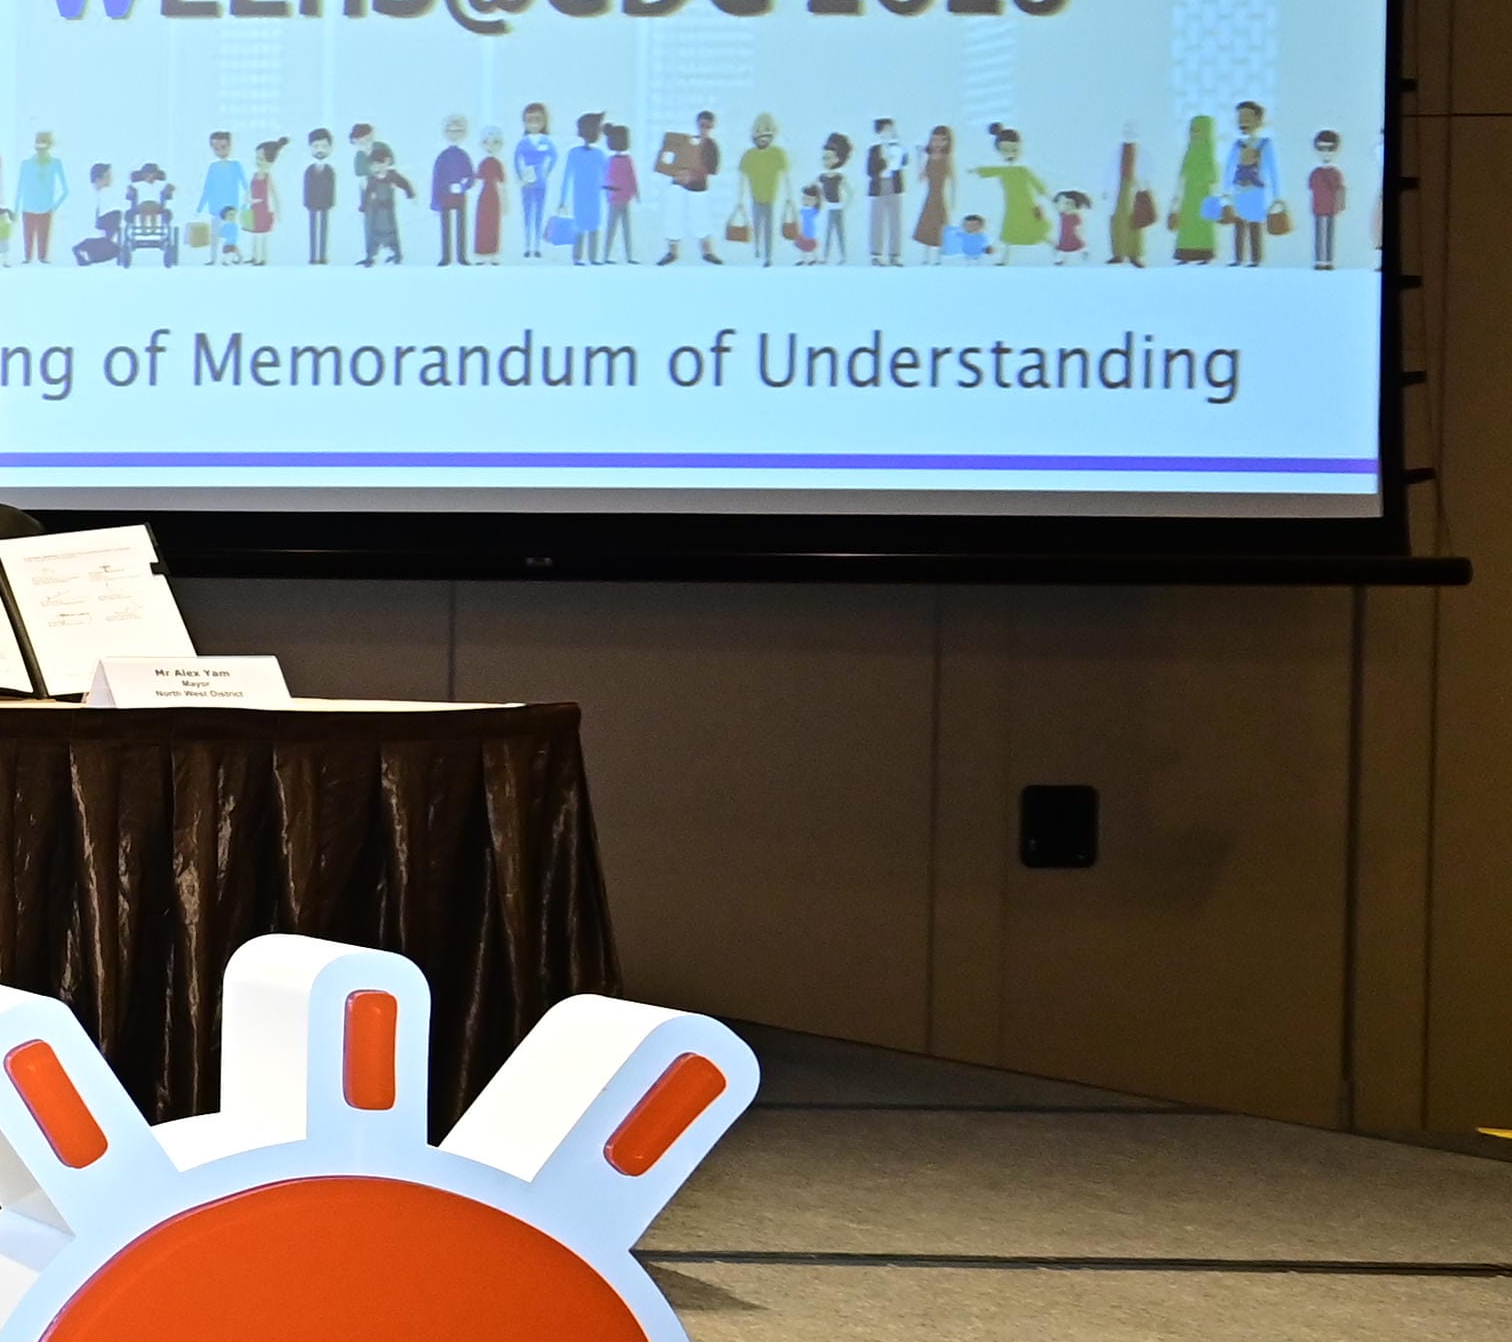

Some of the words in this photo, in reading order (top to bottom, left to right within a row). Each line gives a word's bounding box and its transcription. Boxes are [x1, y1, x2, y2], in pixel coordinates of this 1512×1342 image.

[103, 328, 171, 387] of
[193, 328, 640, 388] Memorandum
[668, 328, 737, 388] of
[758, 329, 1242, 405] Understanding
[154, 669, 170, 677] Mr
[174, 669, 201, 677] Alex
[203, 669, 231, 677] Yam
[181, 680, 211, 688] Mayor
